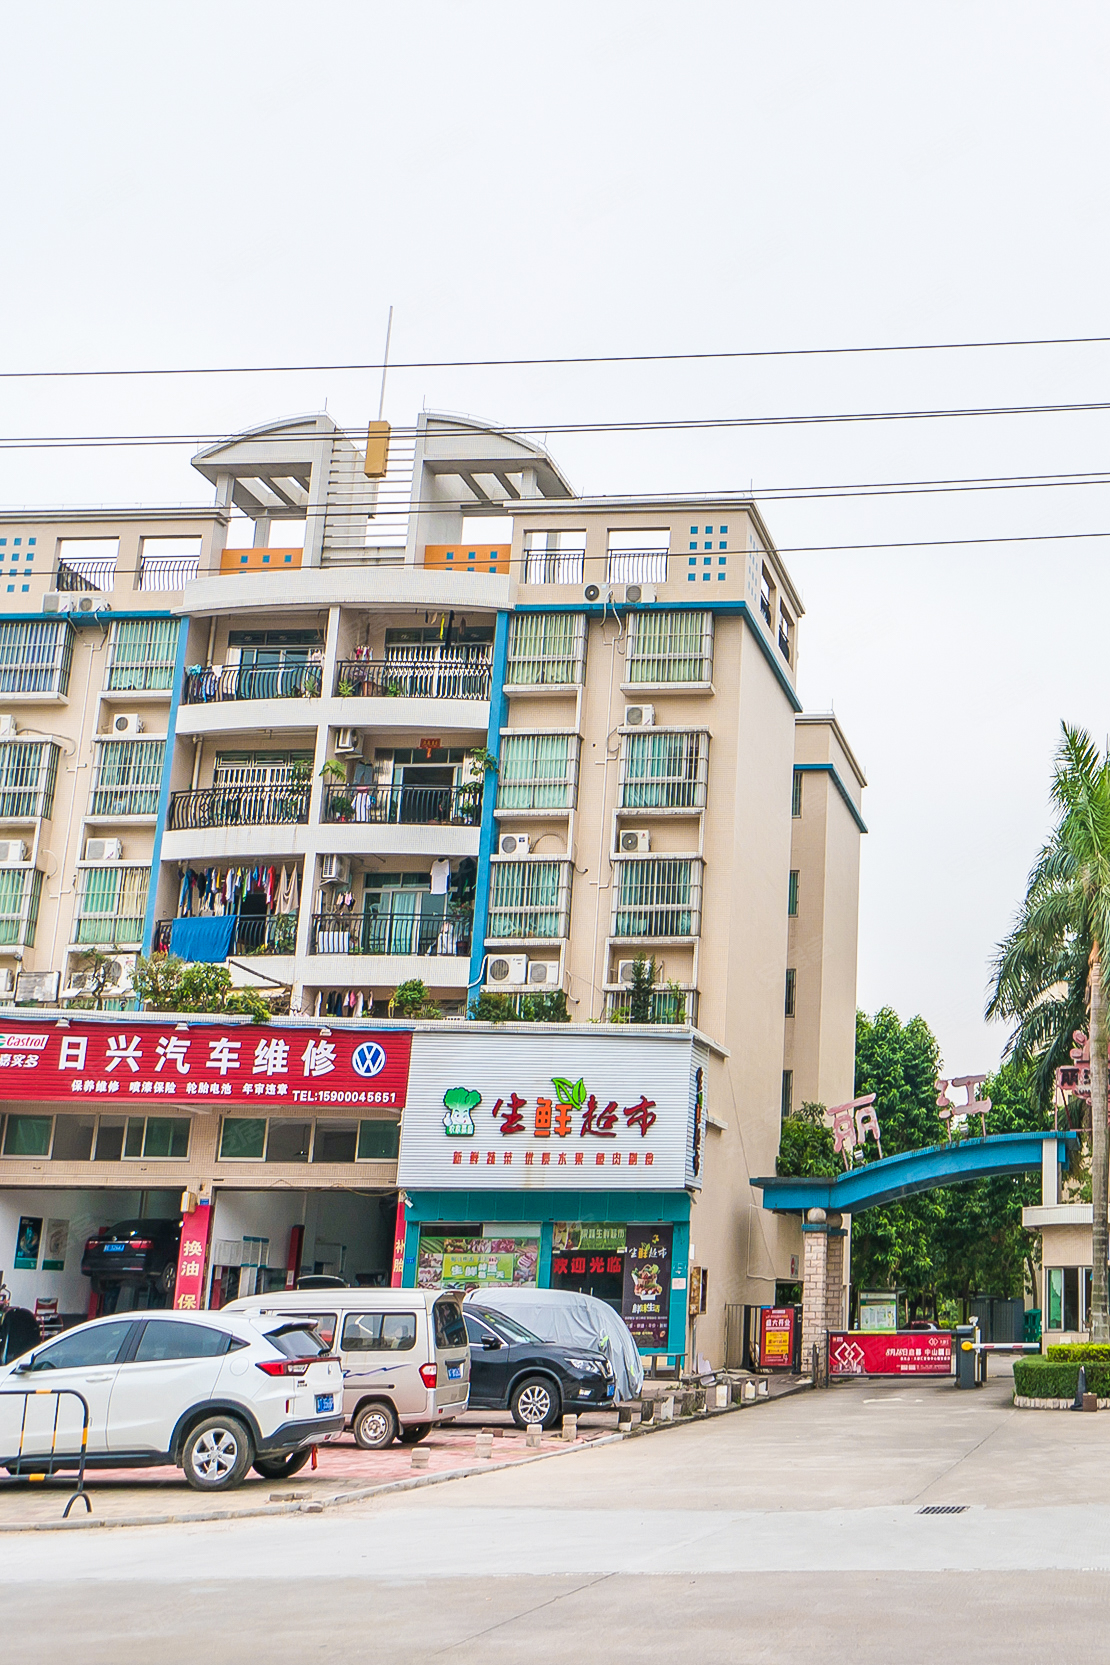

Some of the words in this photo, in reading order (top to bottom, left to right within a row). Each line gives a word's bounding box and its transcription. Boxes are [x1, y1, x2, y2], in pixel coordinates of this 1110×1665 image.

[7, 1035, 46, 1048] Castrol
[58, 1034, 337, 1077] 日兴汽车维修
[71, 1079, 120, 1093] 保养维修
[129, 1081, 177, 1094] 喷漆保险
[186, 1082, 232, 1096] 轮胎电池
[242, 1082, 288, 1096] 年审违章
[292, 1090, 396, 1104] TEL:15900045651
[492, 1088, 656, 1137] 生鲜超市
[180, 1240, 202, 1277] 换油
[553, 1257, 622, 1273] 欢迎光临
